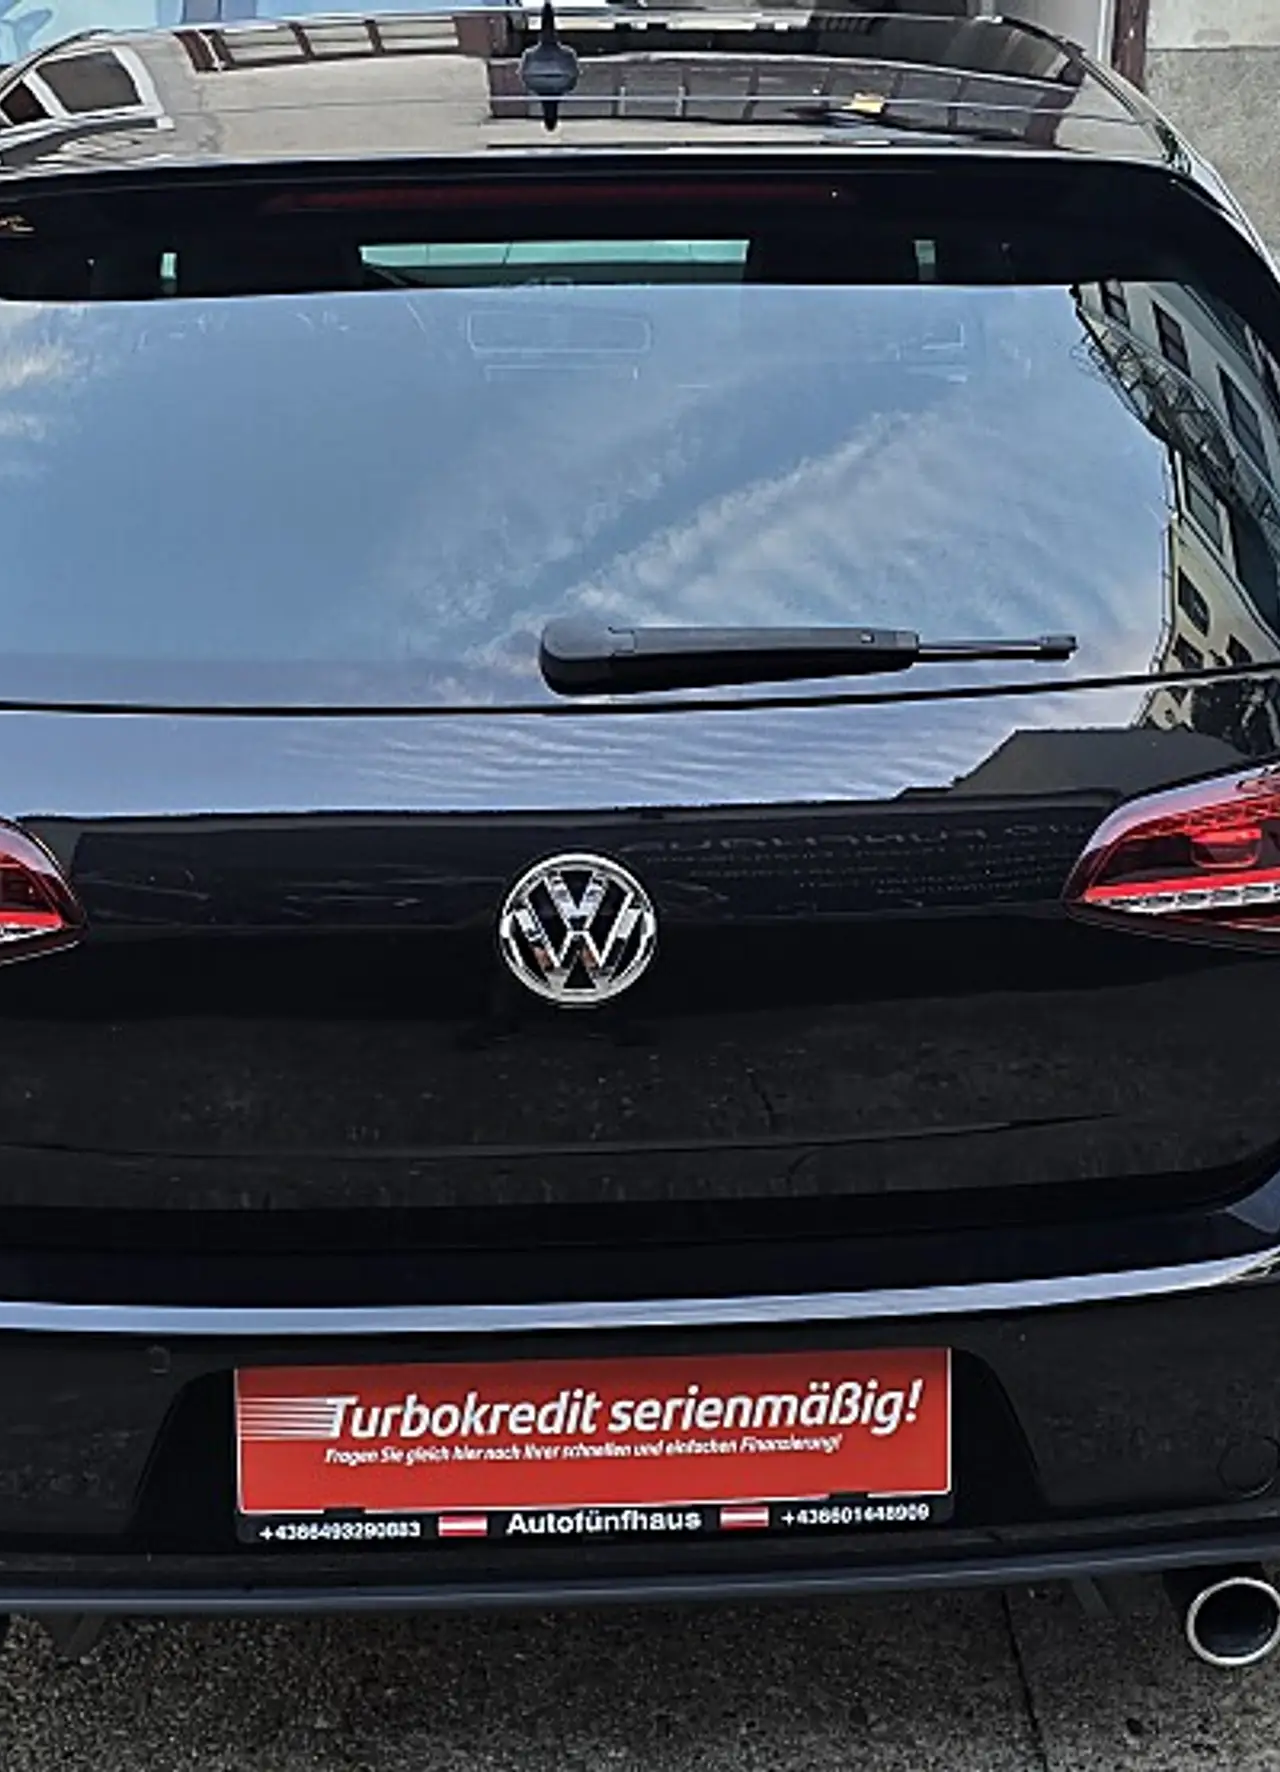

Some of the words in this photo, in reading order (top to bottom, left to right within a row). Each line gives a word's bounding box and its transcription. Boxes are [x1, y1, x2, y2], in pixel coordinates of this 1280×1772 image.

[500, 853, 656, 1002] VW
[325, 1388, 602, 1439] Turbokredit
[608, 1378, 924, 1436] serienmäßig!
[325, 1448, 378, 1465] Fragen
[380, 1446, 404, 1463] Sie
[405, 1445, 450, 1466] gleich
[452, 1444, 484, 1462] hier
[483, 1444, 520, 1460] nach
[522, 1442, 560, 1460] Ihrer
[562, 1440, 631, 1459] schnellen
[633, 1439, 664, 1457] und
[666, 1438, 737, 1455] einfachen
[739, 1433, 842, 1454] Finanzierung!
[506, 1509, 702, 1534] Autofünfhaus
